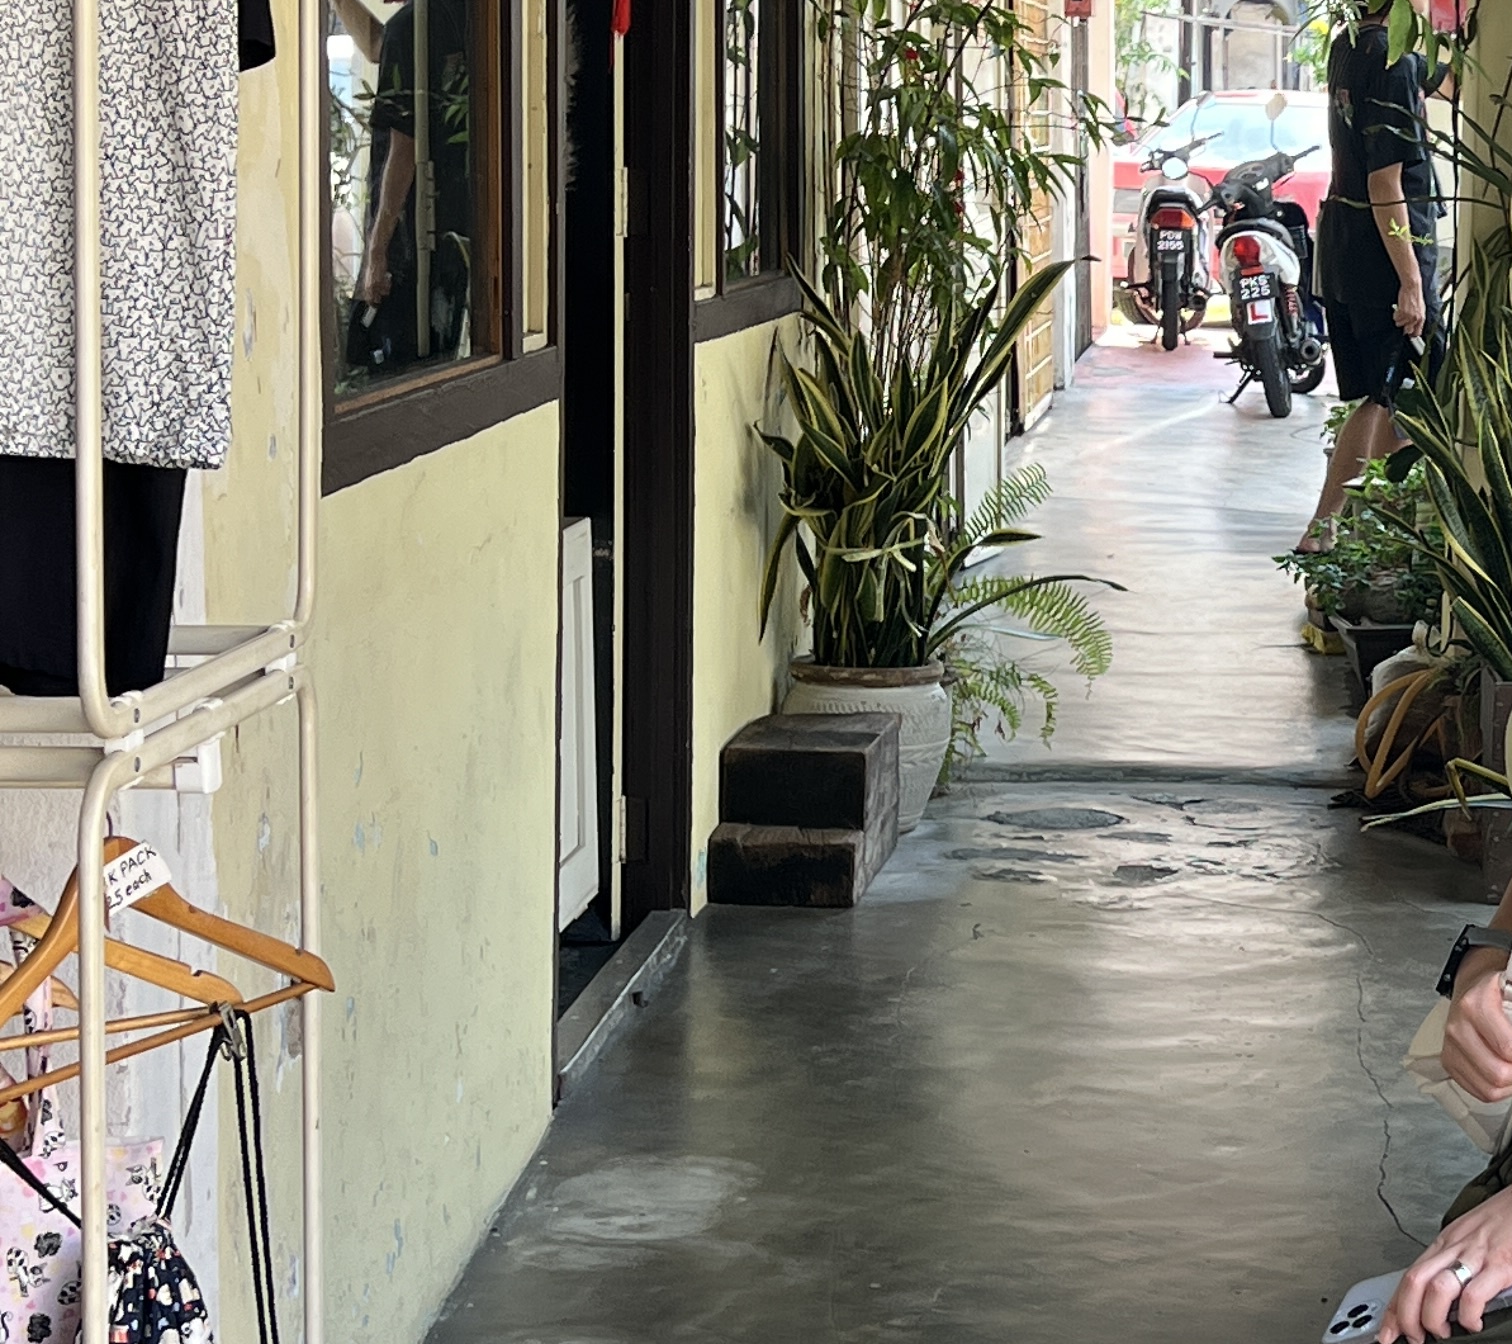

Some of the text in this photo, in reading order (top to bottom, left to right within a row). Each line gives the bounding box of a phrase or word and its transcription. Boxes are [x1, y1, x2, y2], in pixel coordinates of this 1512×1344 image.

[1239, 274, 1268, 289] PKS
[1250, 303, 1269, 321] L
[119, 845, 157, 878] PACK
[125, 868, 153, 897] each
